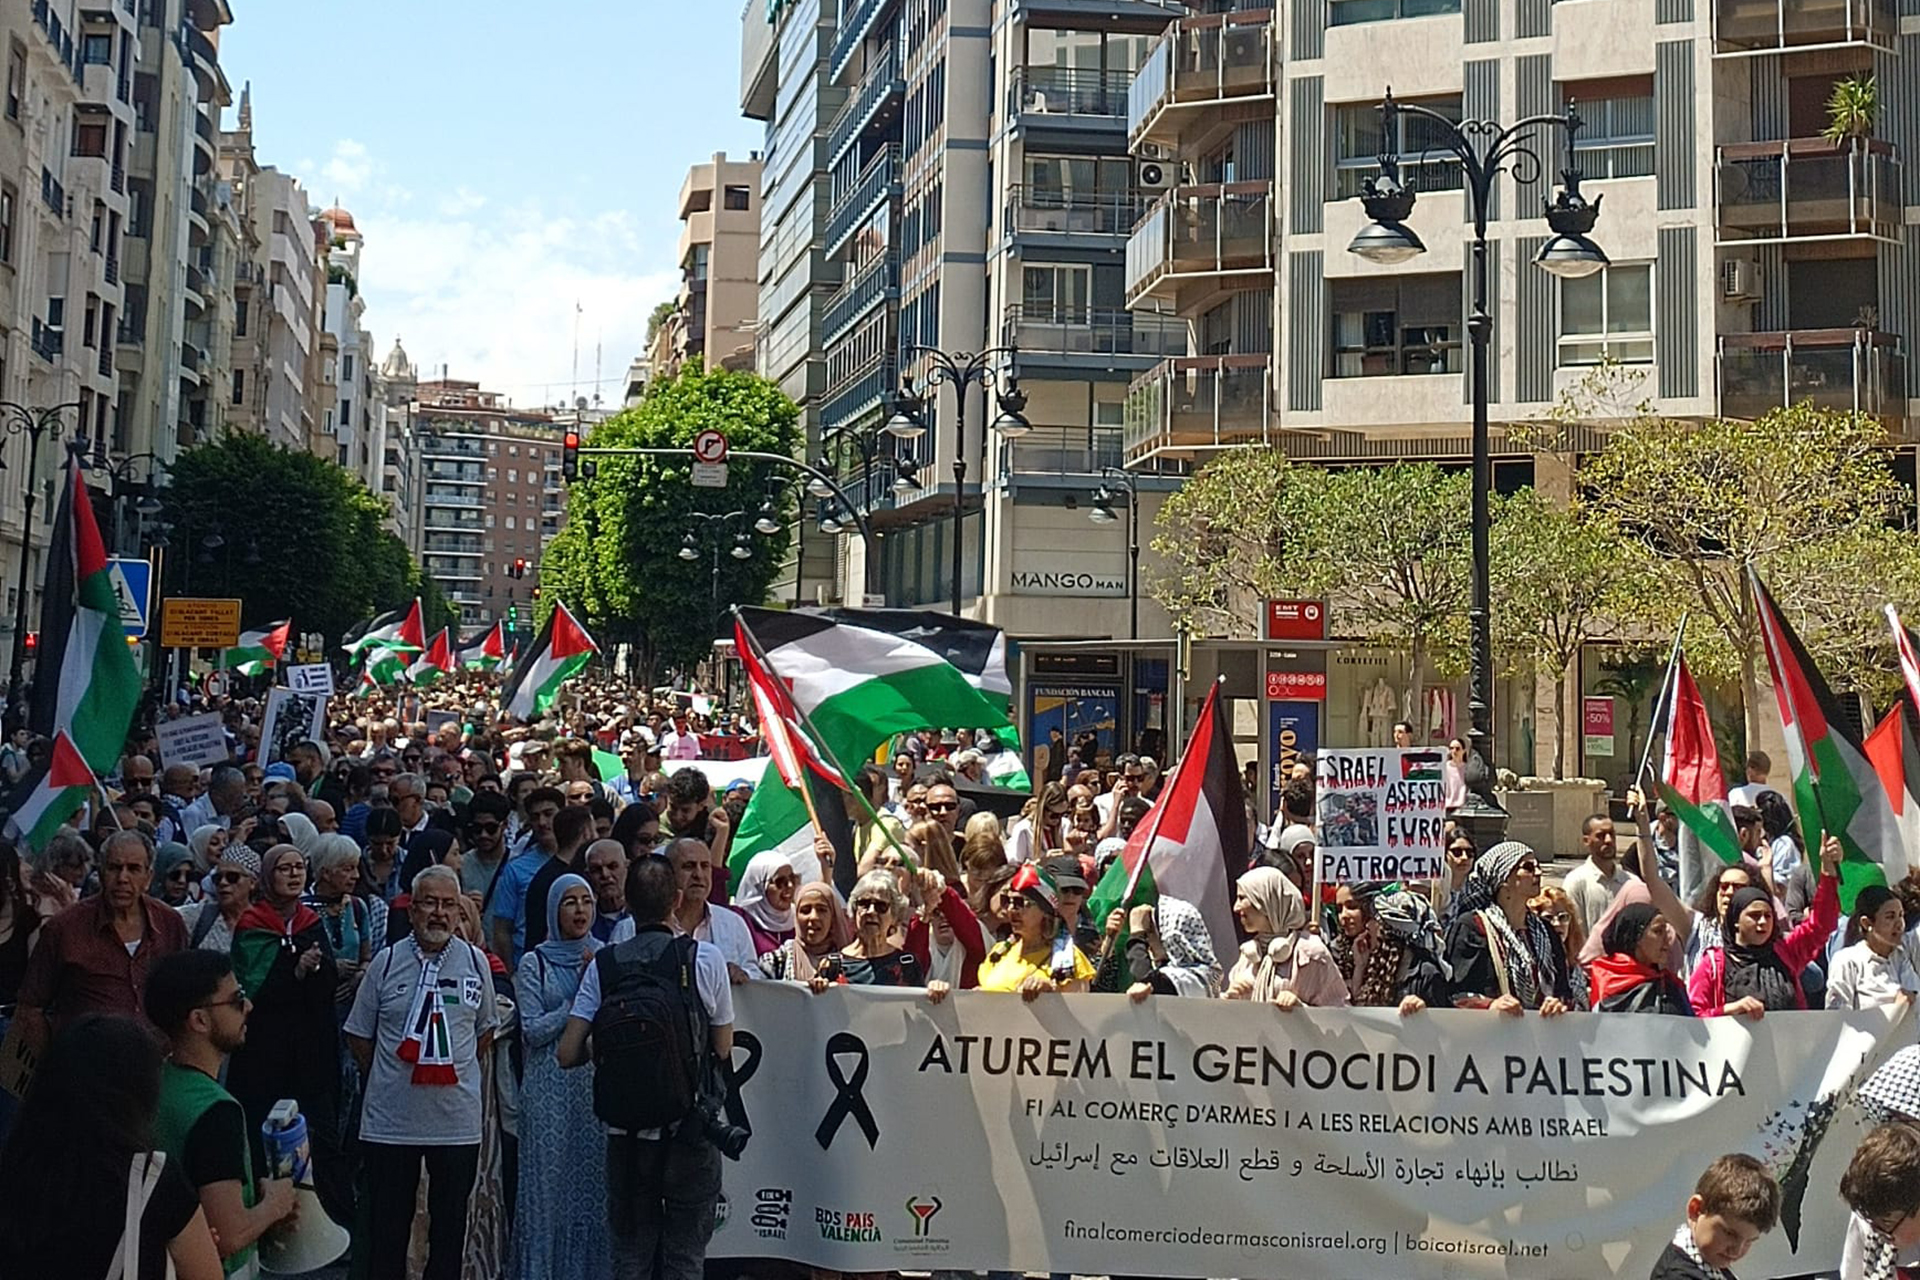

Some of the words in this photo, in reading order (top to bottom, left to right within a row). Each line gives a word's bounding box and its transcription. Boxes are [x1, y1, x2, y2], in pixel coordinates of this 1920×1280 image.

[1011, 572, 1093, 589] MANGO
[1096, 581, 1124, 590] MAN
[1035, 687, 1080, 698] FUNDACIÓN
[1081, 689, 1116, 698] BANCAJA
[1388, 817, 1446, 848] EURO
[1322, 854, 1445, 880] PATROCIN
[918, 1033, 1112, 1079] ATUREM
[1130, 1041, 1176, 1080] EL
[1192, 1044, 1435, 1092] GENOCIDI
[1453, 1054, 1489, 1094] A
[1504, 1055, 1746, 1098] PALESTINA
[1026, 1099, 1042, 1116] FI
[1050, 1100, 1076, 1118] AL
[1085, 1101, 1178, 1128] COMERÇ
[1186, 1104, 1276, 1126] D'ARMES
[1284, 1110, 1290, 1128] I
[1298, 1111, 1314, 1130] A
[1321, 1113, 1353, 1132] LES
[1360, 1114, 1478, 1134] RELACIONS
[1485, 1116, 1532, 1136] AMB
[1540, 1118, 1608, 1137] ISRAEL
[1029, 1141, 1100, 1170] إسرائيل
[1110, 1153, 1138, 1175] مع
[1150, 1146, 1229, 1170] العلاقات
[1238, 1148, 1280, 1181] قطع
[1289, 1158, 1303, 1176] و
[1313, 1151, 1385, 1181] الأسلحة
[1395, 1157, 1444, 1184] تجارة
[1455, 1158, 1505, 1188] بإنهاء
[1516, 1159, 1578, 1189] نطالب
[815, 1206, 841, 1226] BDS
[846, 1212, 875, 1228] PAÍS
[820, 1224, 882, 1242] VALENCIÀ
[1064, 1219, 1387, 1255] finalcomerciodearmasconisrael.org
[1406, 1233, 1549, 1257] boicotisrael.net
